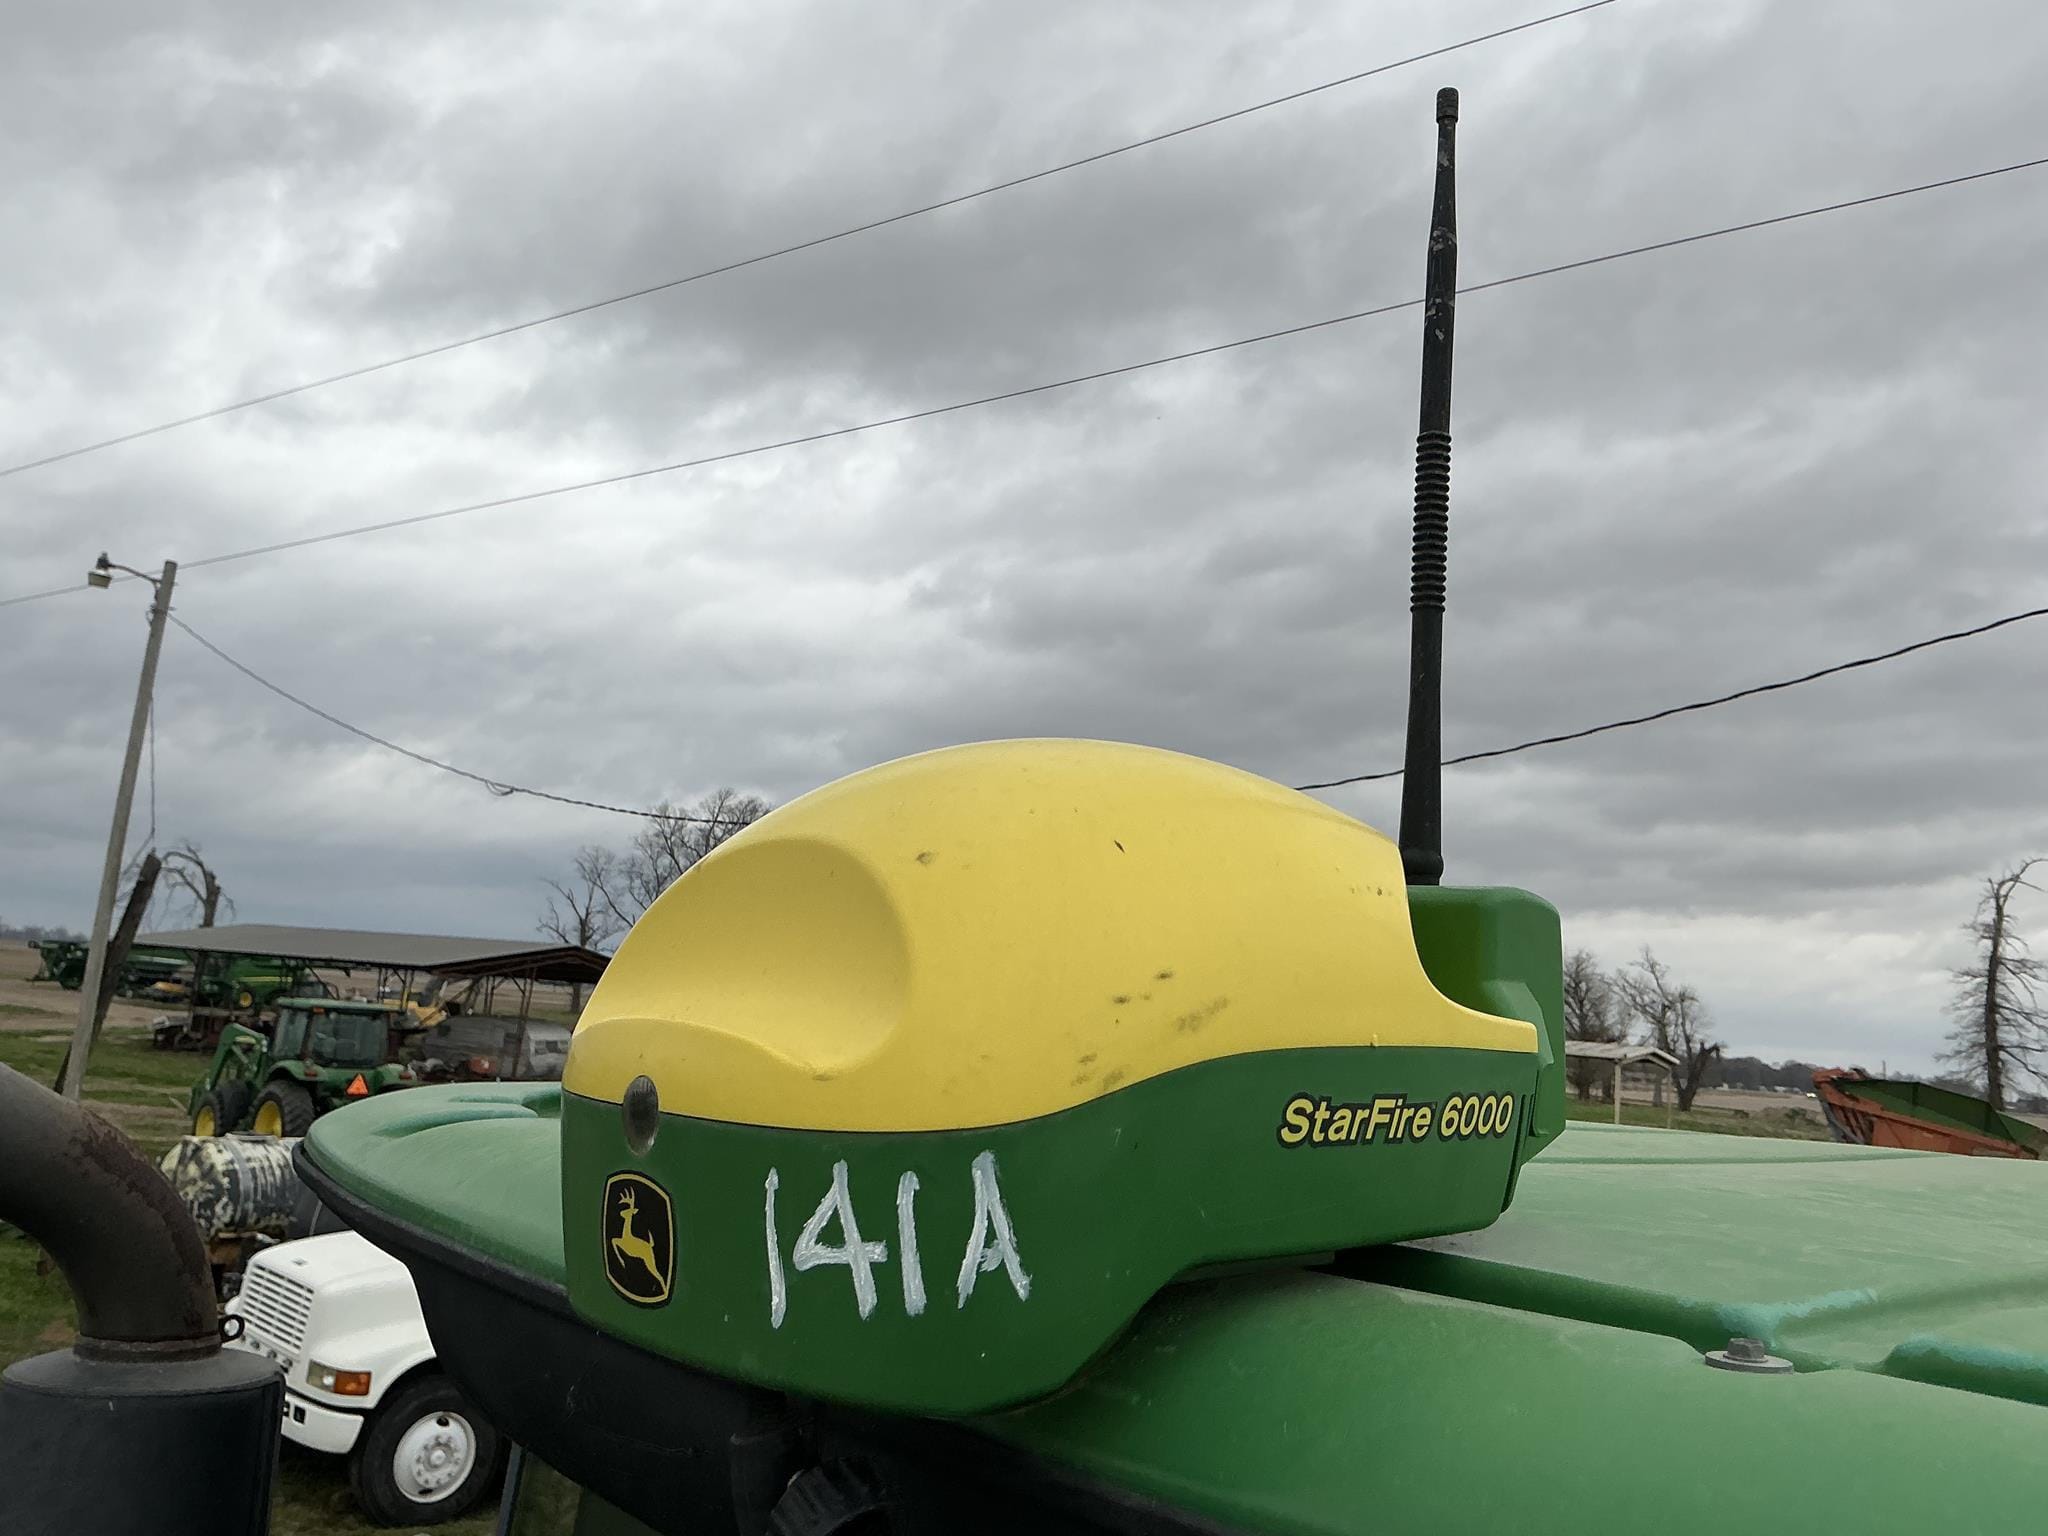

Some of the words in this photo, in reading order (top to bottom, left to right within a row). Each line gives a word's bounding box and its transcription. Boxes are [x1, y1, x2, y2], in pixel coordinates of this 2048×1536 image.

[1279, 1096, 1433, 1144] StarFire
[1440, 1094, 1513, 1138] 6000
[765, 1149, 1032, 1330] 141A
